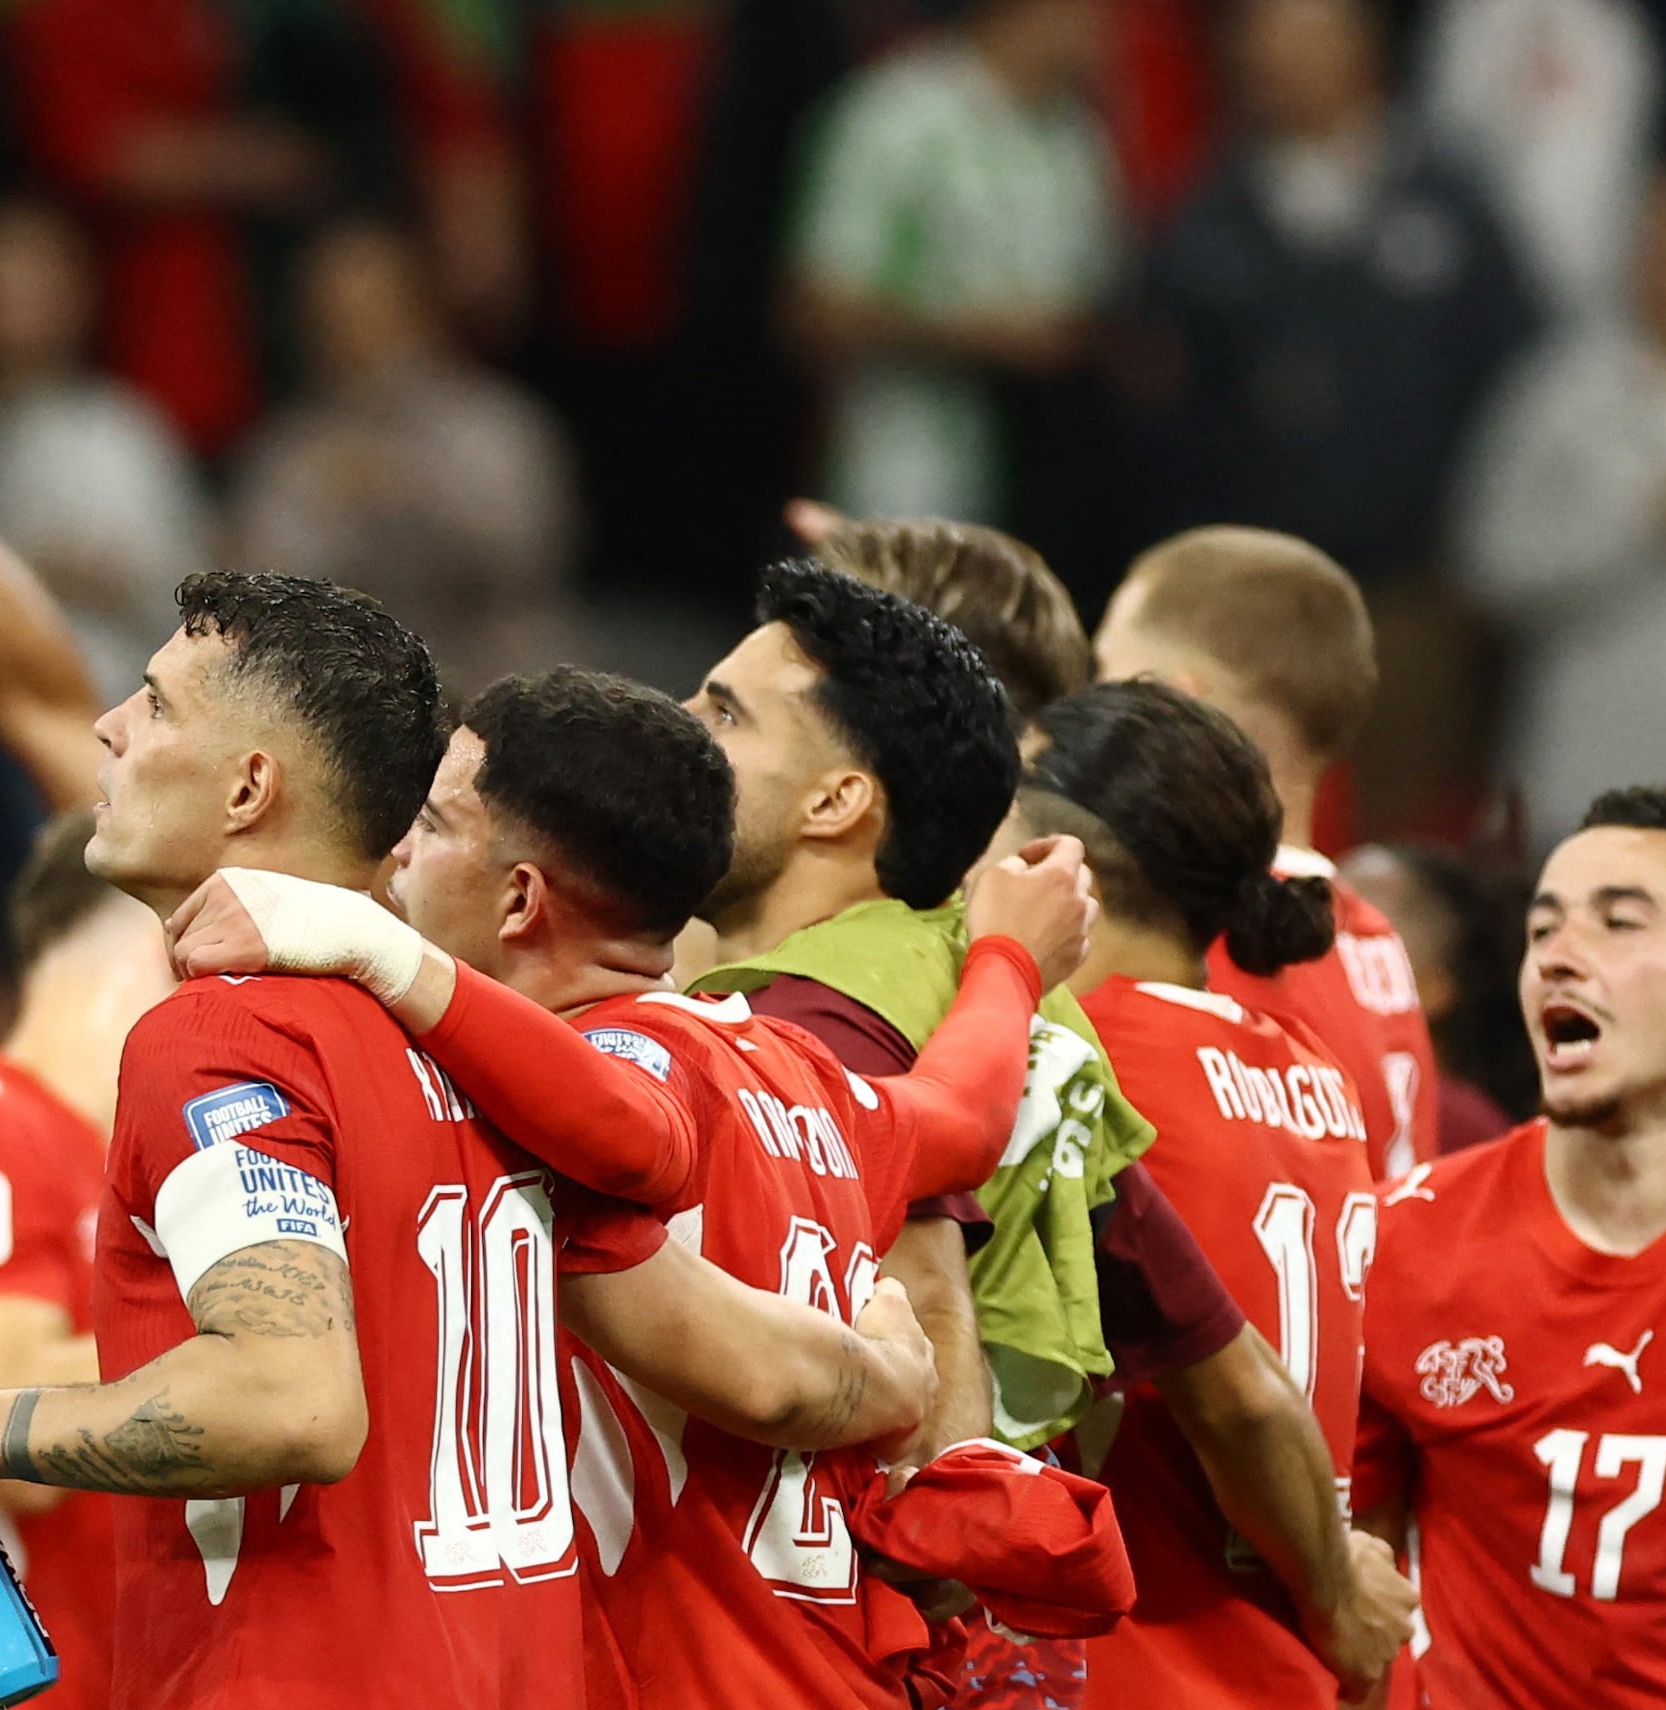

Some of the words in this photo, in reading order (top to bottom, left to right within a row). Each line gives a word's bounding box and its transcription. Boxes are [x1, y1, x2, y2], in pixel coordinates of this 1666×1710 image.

[203, 1095, 270, 1128] FOOTBALL
[240, 1167, 330, 1205] UNITES
[242, 1196, 278, 1218] the
[281, 1195, 337, 1233] World
[277, 1218, 317, 1236] FIFA
[414, 1171, 579, 1592] 10
[742, 1215, 881, 1605] 2
